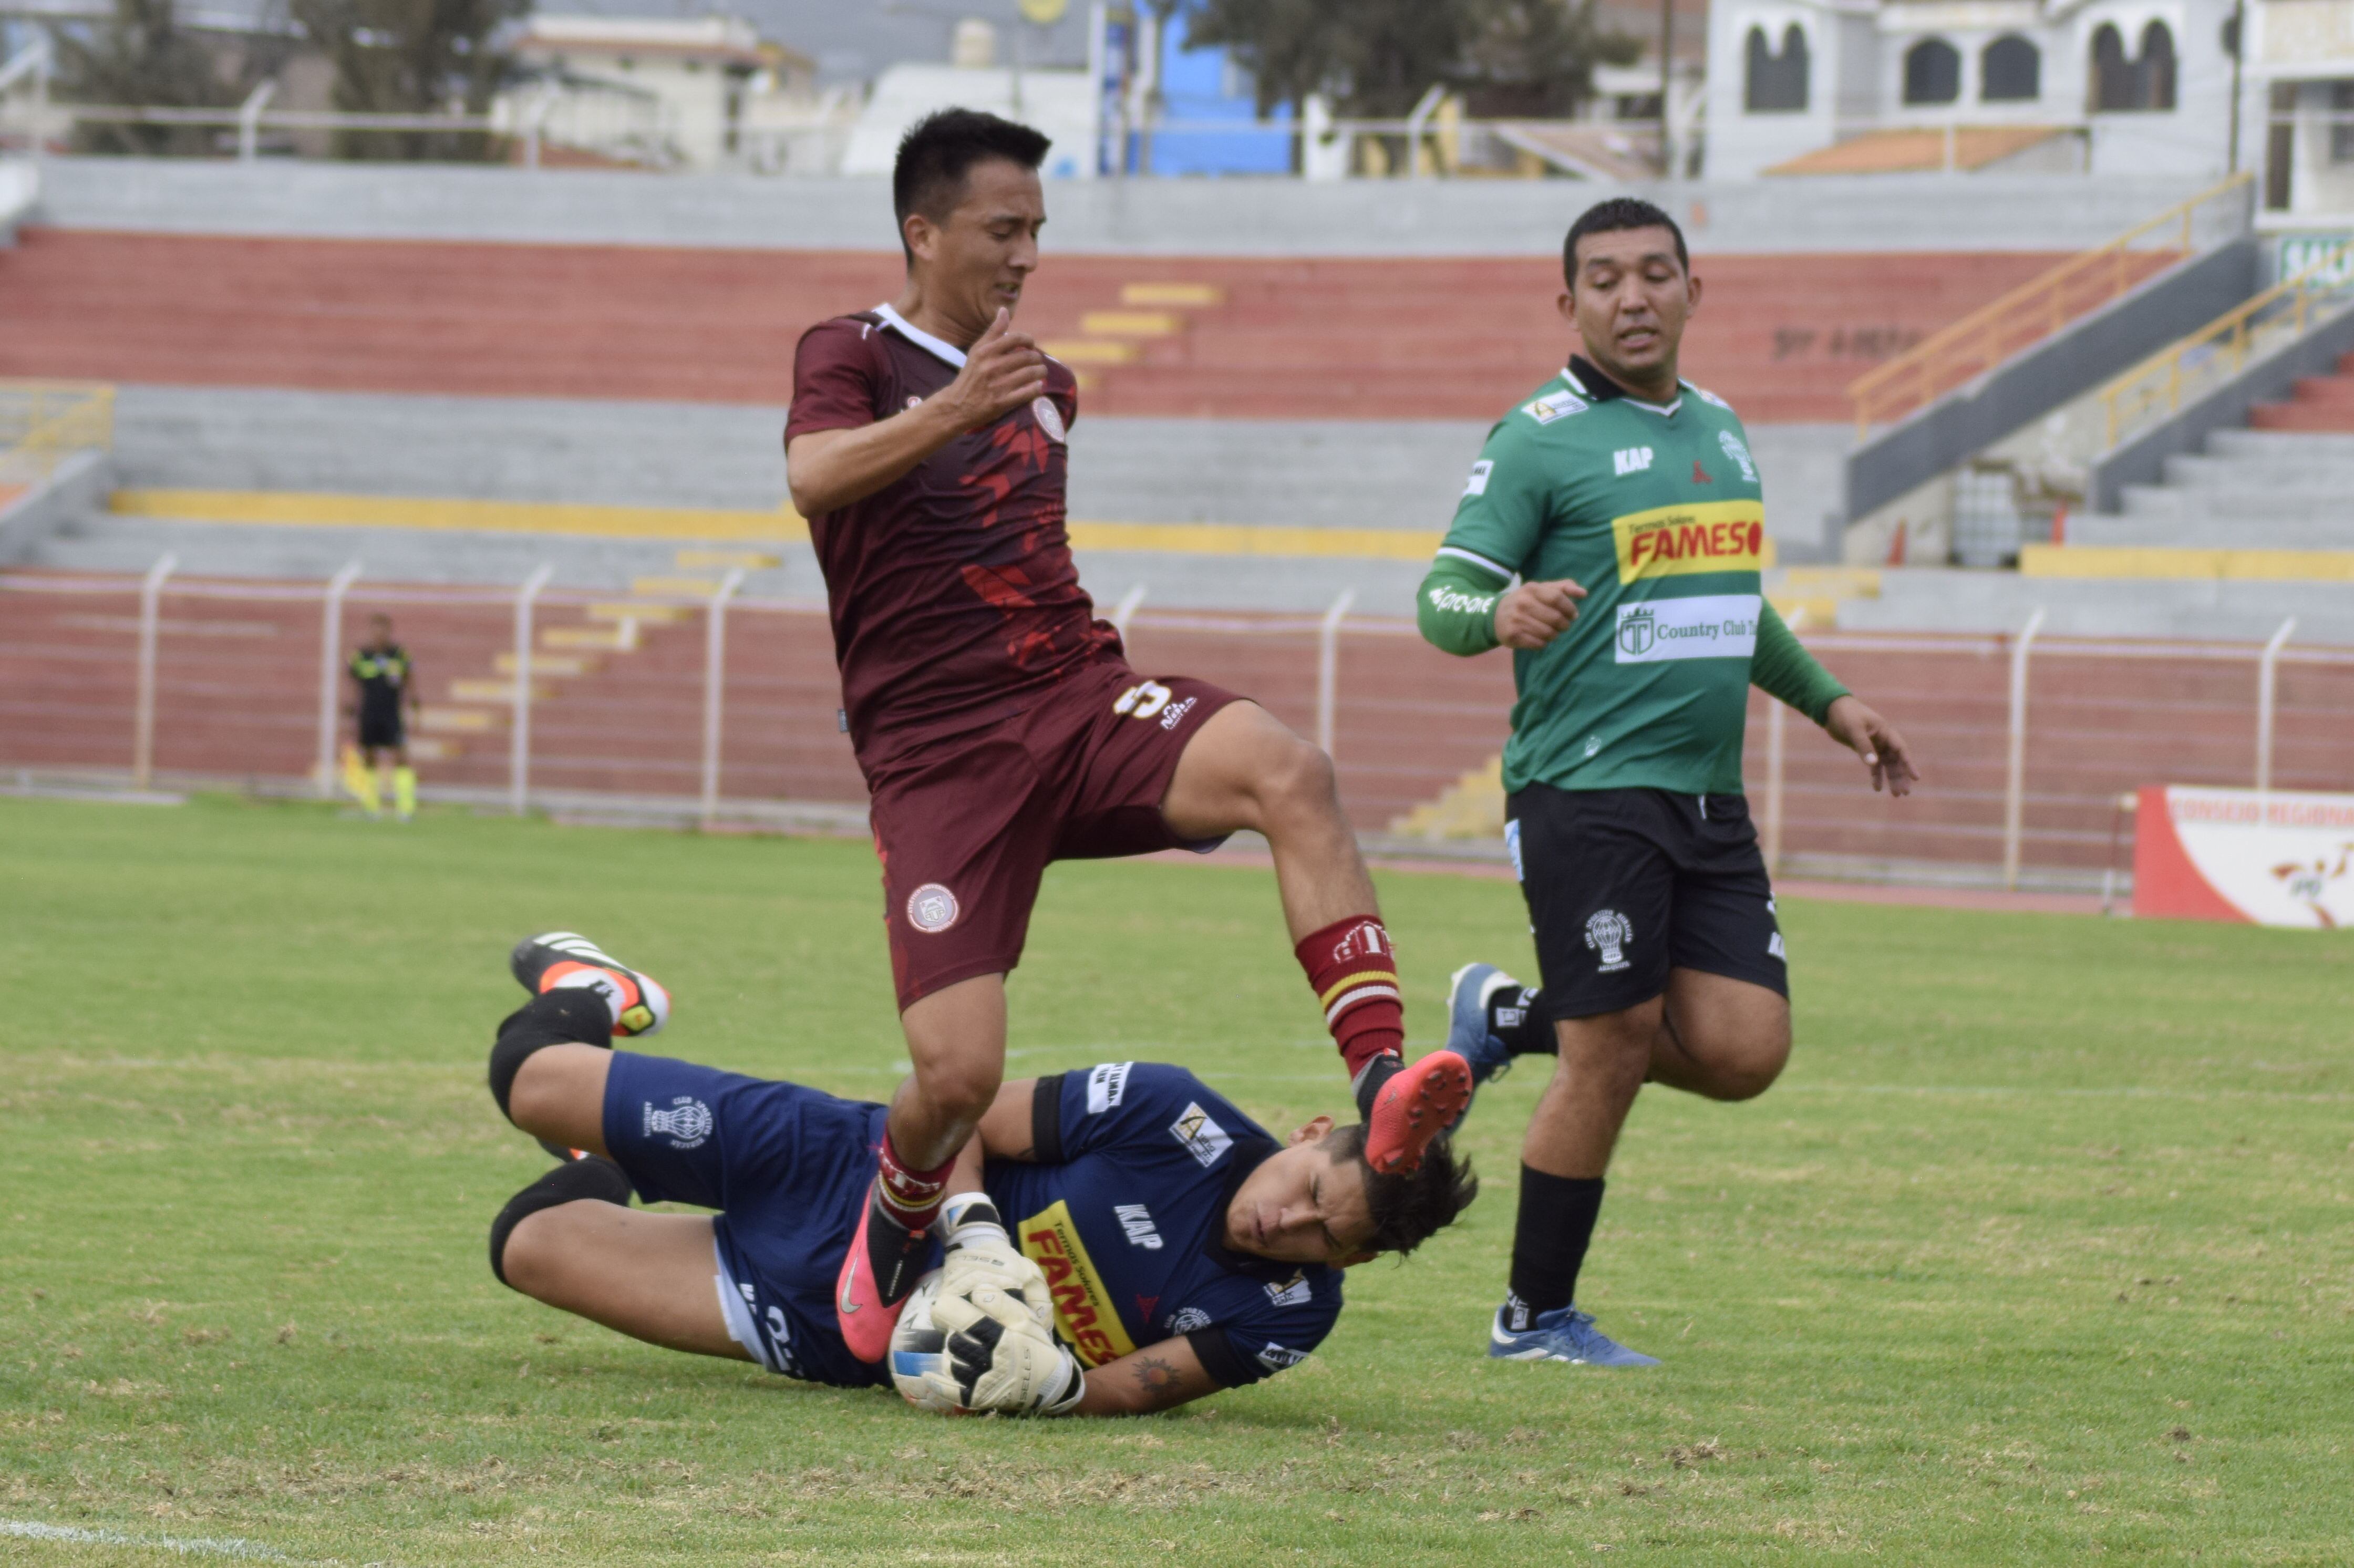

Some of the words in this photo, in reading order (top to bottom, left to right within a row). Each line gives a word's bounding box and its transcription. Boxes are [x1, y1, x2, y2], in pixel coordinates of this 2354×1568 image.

[1613, 447, 1654, 476] KAP
[1657, 622, 1719, 641] Country
[1723, 620, 1747, 636] Club
[1114, 1204, 1164, 1250] KAP
[1054, 1220, 1079, 1265] Termas
[1076, 1263, 1099, 1307] Solares
